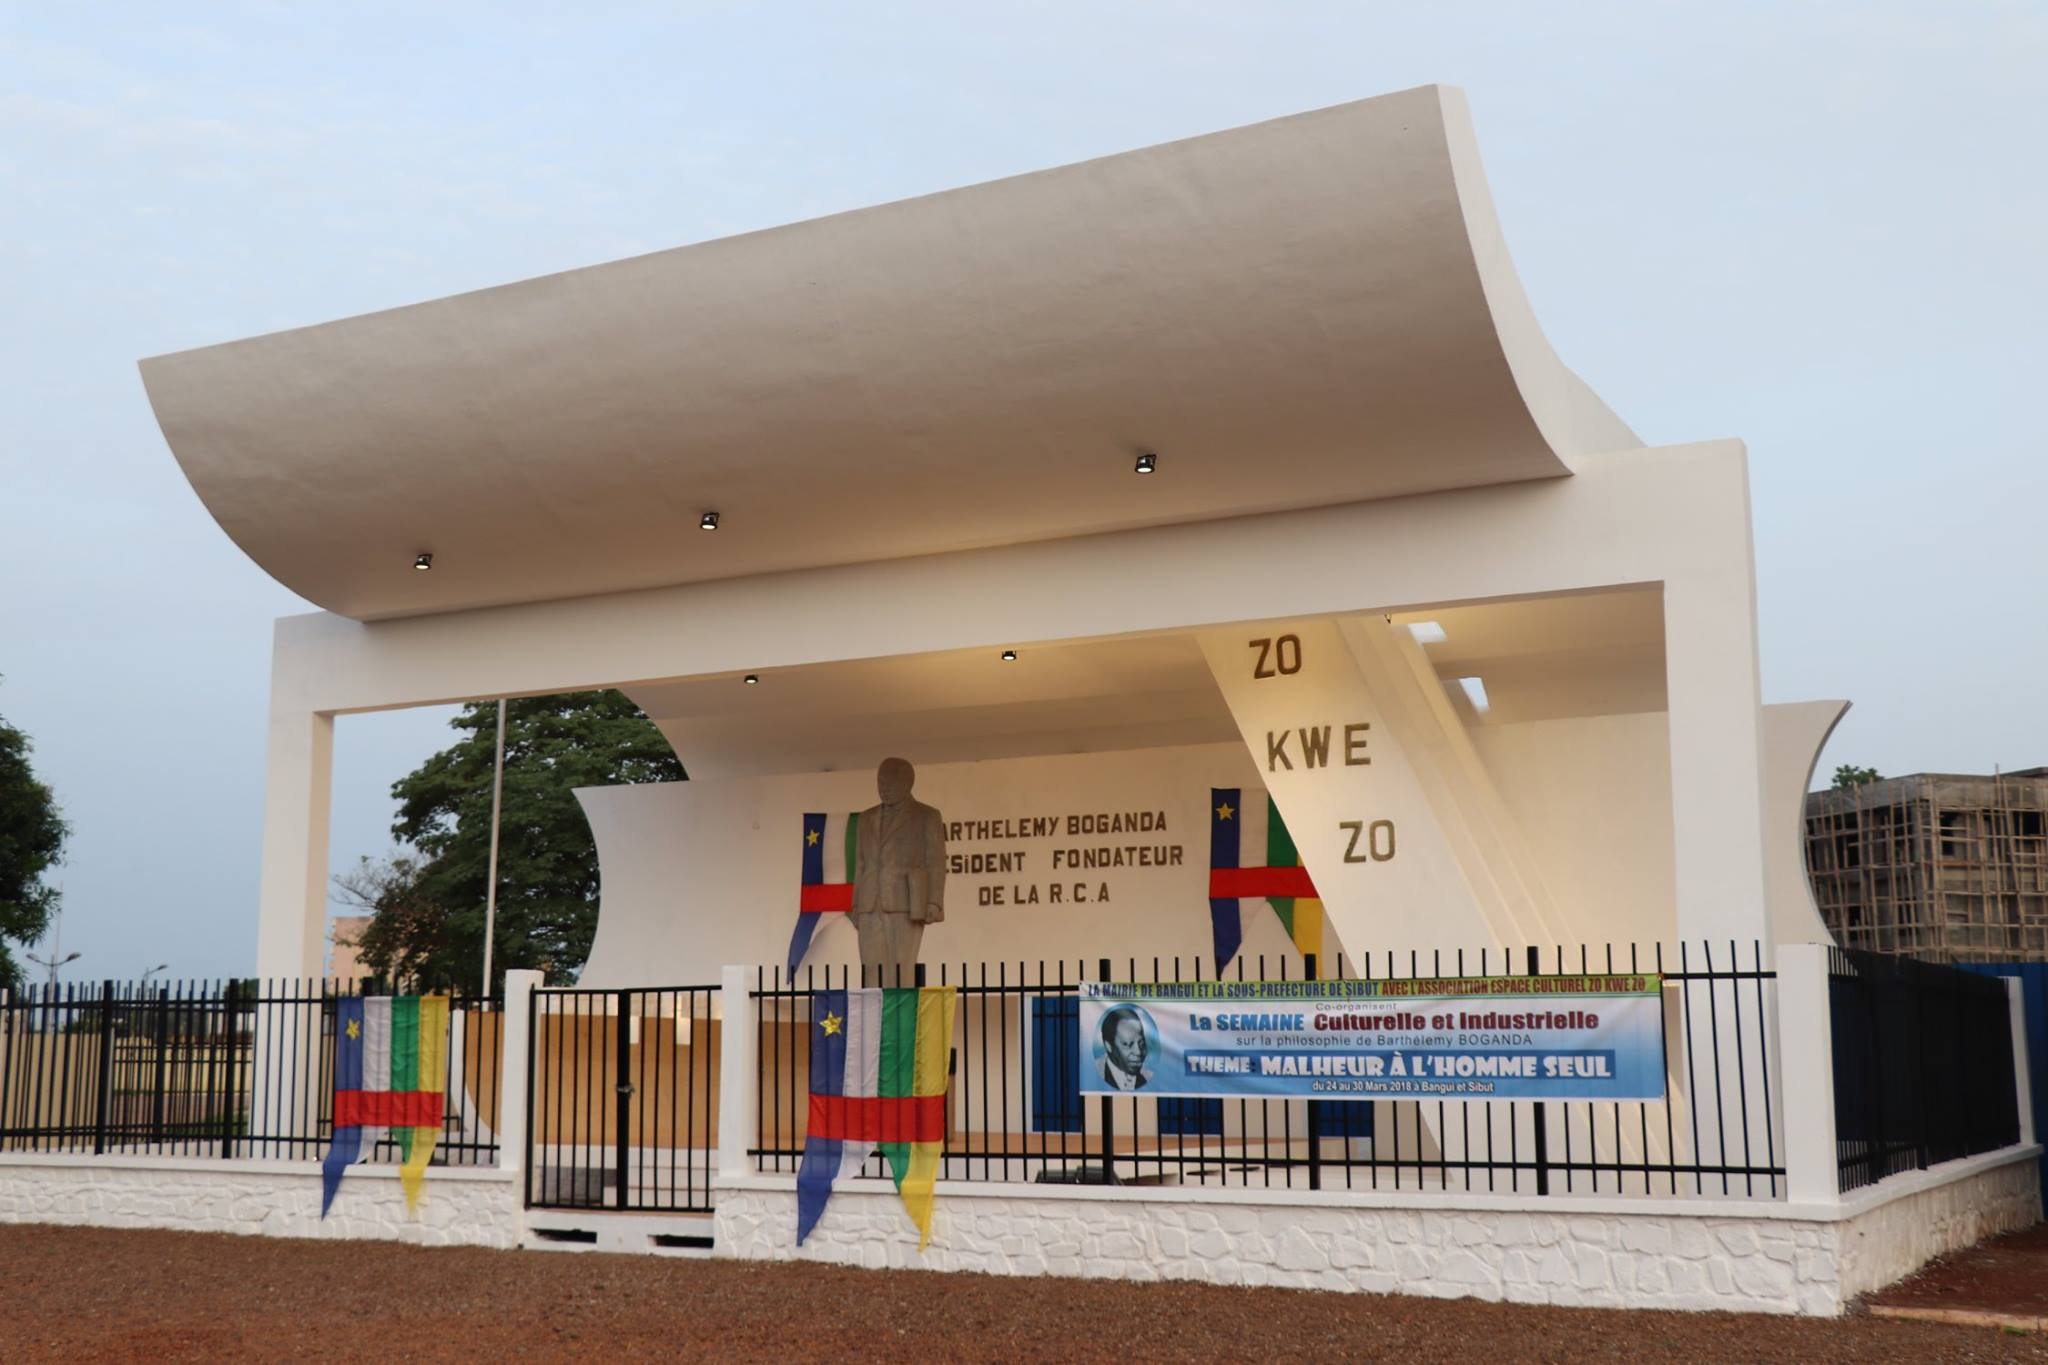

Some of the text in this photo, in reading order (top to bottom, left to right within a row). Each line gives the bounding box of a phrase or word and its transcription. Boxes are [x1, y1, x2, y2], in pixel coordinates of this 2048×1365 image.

[1249, 634, 1302, 679] ZO
[1267, 723, 1371, 772] KWE
[1067, 811, 1167, 835] BOGANDA
[1339, 819, 1396, 863] ZO
[1053, 845, 1183, 869] FONDATEUR
[978, 886, 1005, 906] DE
[1014, 885, 1039, 904] LA
[1088, 976, 1646, 997] LA MAIRIE DE BANGUI ET LA SOUS-PREFECTURE DE SIBUT AVEC L'ASSOCIATION ESPACE CULTUREL ZO KWE ZO
[1315, 1003, 1397, 1012] Co-organisent
[1189, 1011, 1600, 1031] La SEMAINE Culturelle et Industrielle
[1236, 1037, 1256, 1046] sur
[1261, 1036, 1272, 1046] la
[1276, 1035, 1351, 1048] philosophie
[1356, 1035, 1372, 1046] de
[1459, 1034, 1533, 1046] BOGANDA
[1261, 1056, 1385, 1077] MALHEUR
[1389, 1050, 1408, 1077] À
[1412, 1055, 1537, 1077] L'HOMME
[1543, 1055, 1611, 1077] SEUL
[1312, 1081, 1325, 1092] du
[1326, 1081, 1337, 1092] 24
[1339, 1082, 1351, 1092] au
[1352, 1081, 1364, 1092] 30
[1365, 1081, 1388, 1092] Mars
[1390, 1081, 1412, 1092] 2018
[1422, 1081, 1455, 1095] Bangui
[1457, 1082, 1467, 1092] et
[1468, 1081, 1494, 1093] Sibut
